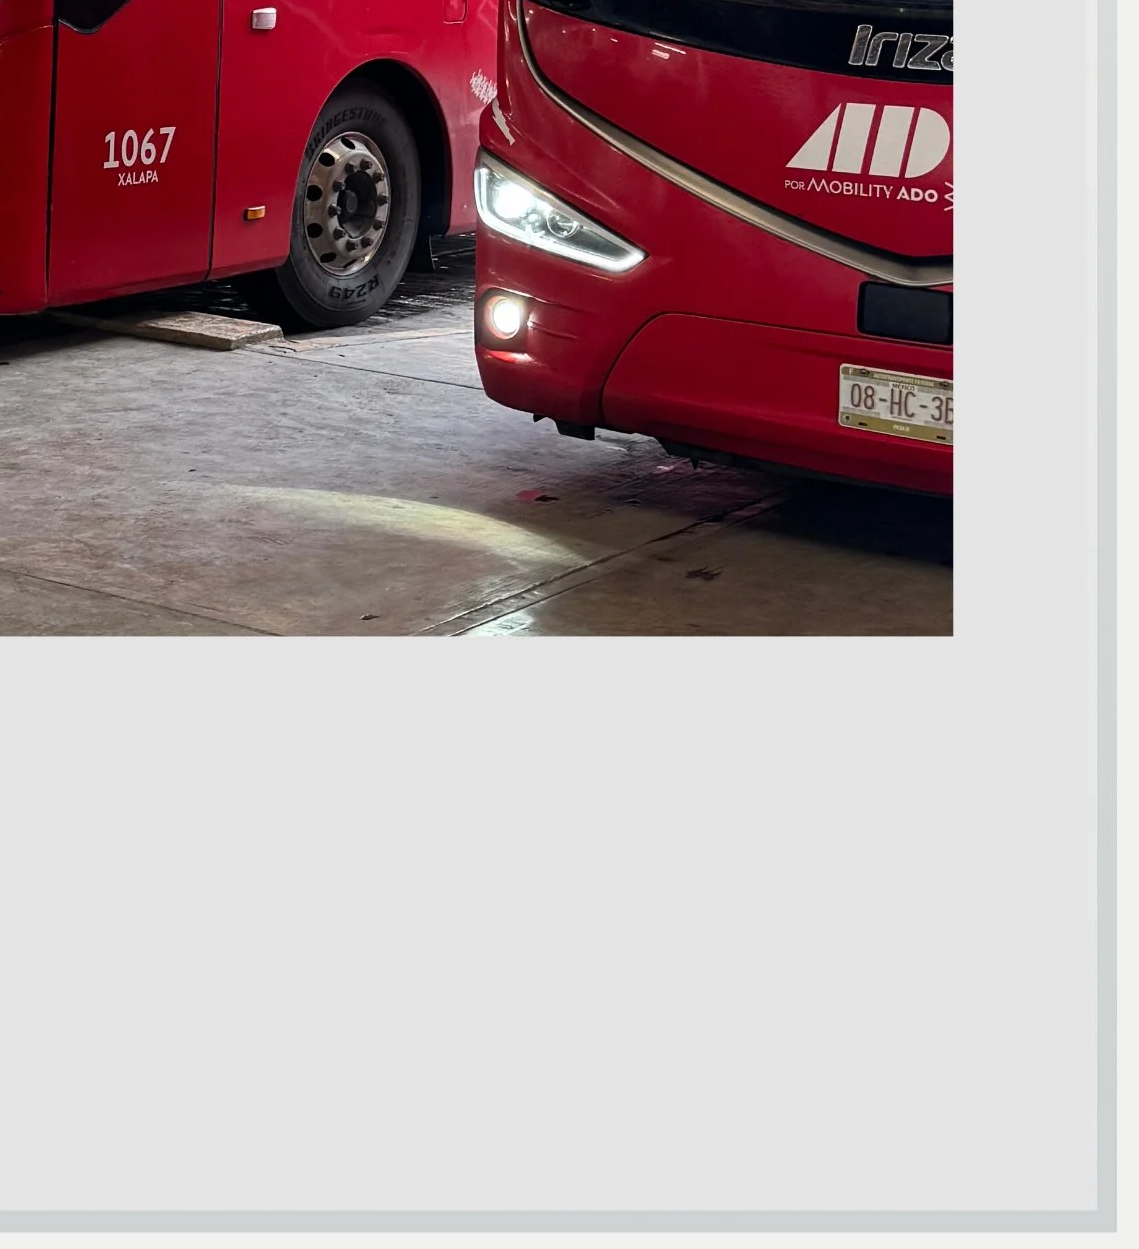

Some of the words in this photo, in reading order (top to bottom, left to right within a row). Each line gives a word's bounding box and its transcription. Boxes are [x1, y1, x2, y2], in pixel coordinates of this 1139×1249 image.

[103, 126, 177, 169] 1067
[118, 169, 158, 186] XALAPA
[784, 179, 805, 191] POR
[807, 177, 893, 199] MOBILITY
[896, 186, 938, 203] ADO
